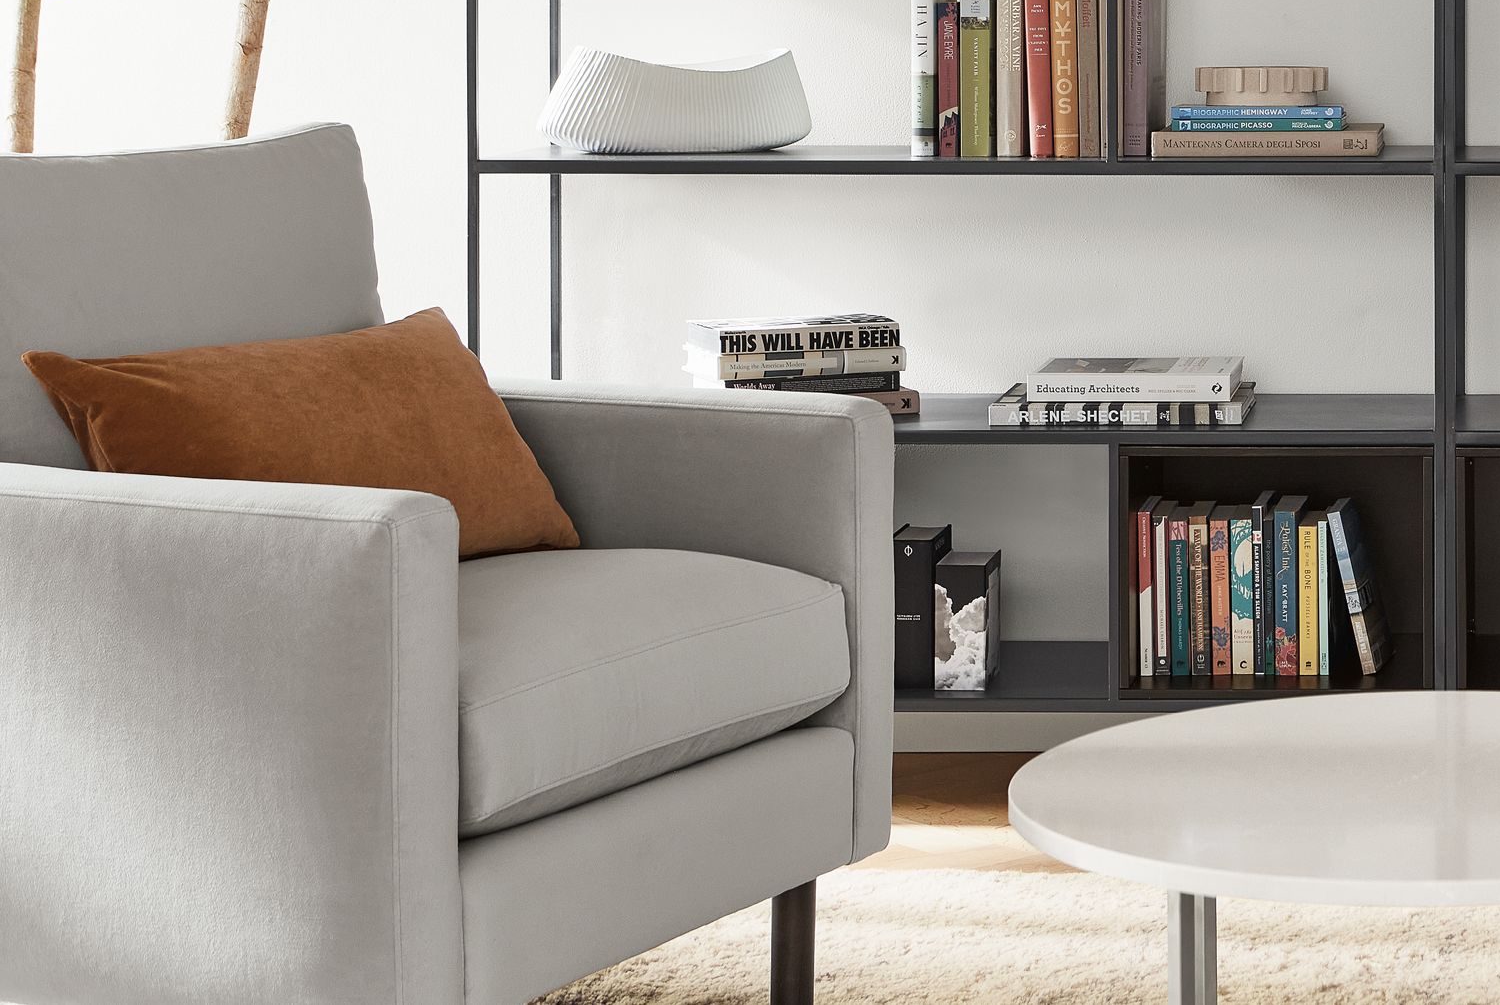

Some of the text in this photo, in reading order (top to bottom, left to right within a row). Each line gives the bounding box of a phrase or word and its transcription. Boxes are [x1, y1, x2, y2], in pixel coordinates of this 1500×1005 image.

[916, 6, 927, 58] HA JIN
[943, 21, 953, 40] JANE
[944, 42, 953, 60] EYRE
[1012, 45, 1021, 71] VINE
[1054, 0, 1072, 115] MYTHOS
[1163, 138, 1320, 148] MANTEGNA'S CAMERA DEGLI SPOSI
[720, 329, 900, 353] THIS WILL HAVE BEEN
[730, 362, 748, 370] Making
[759, 382, 776, 390] Away
[1036, 383, 1140, 395] Educating Architects
[1007, 410, 1070, 422] ARLENE
[1077, 410, 1151, 422] SHECHET
[1332, 519, 1342, 546] GRANTA
[1214, 555, 1225, 582] EMMA
